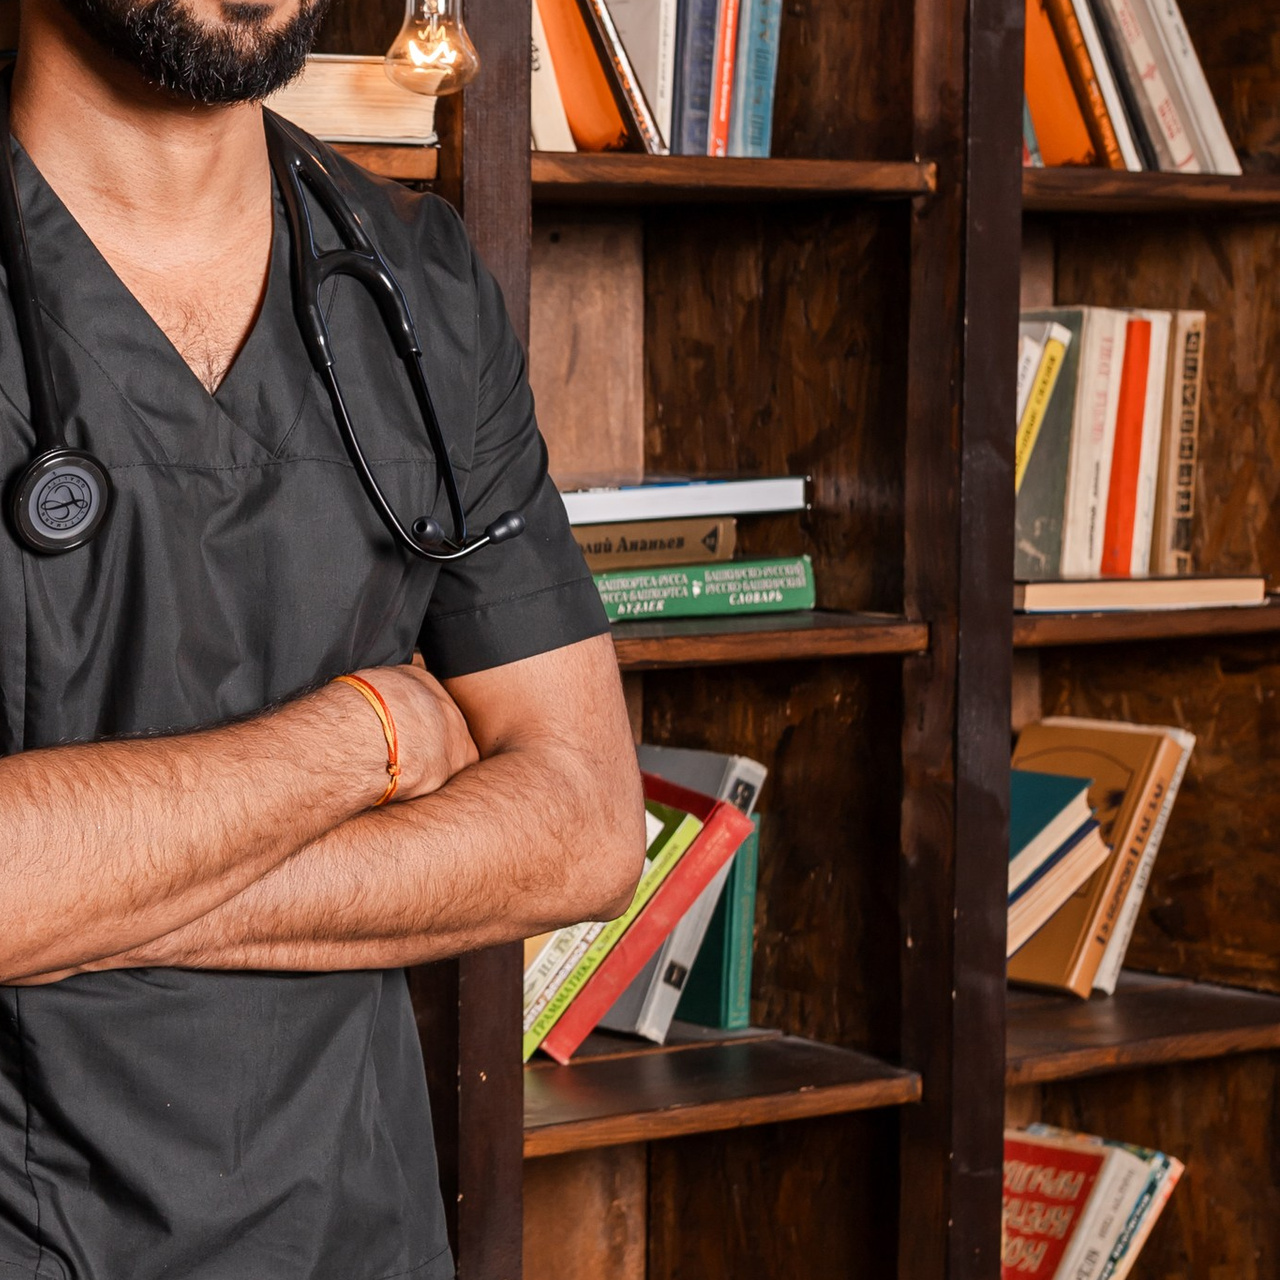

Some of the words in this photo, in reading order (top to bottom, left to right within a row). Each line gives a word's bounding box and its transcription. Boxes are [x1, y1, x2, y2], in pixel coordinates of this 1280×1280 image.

[616, 536, 685, 553] Ананьев
[728, 592, 783, 606] СЛОВАРЬ
[532, 953, 597, 1038] ГРАММАТИКА
